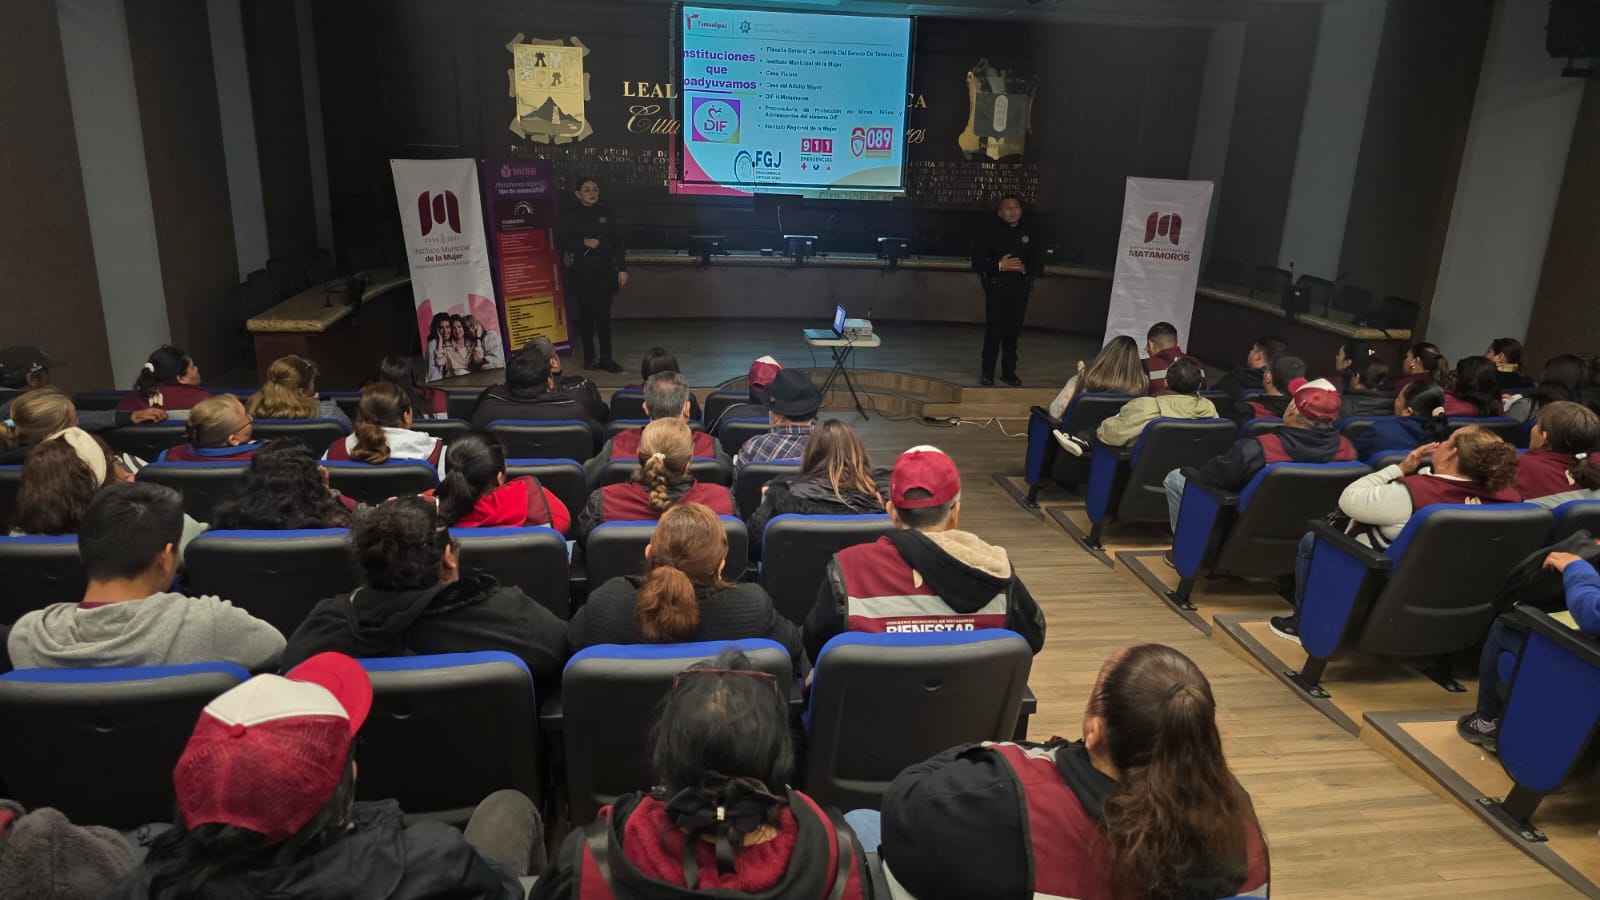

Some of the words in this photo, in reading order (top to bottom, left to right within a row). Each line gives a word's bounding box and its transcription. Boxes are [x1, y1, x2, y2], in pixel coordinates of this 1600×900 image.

[706, 65, 728, 75] que
[622, 80, 678, 99] LEAL
[704, 120, 728, 132] DIF
[867, 129, 892, 149] 089
[803, 139, 831, 152] 911
[756, 151, 782, 168] FGJ
[512, 167, 537, 176] MUJER
[441, 243, 471, 254] Municipal
[443, 252, 463, 262] Mujer
[1128, 249, 1190, 261] MATAMOROS
